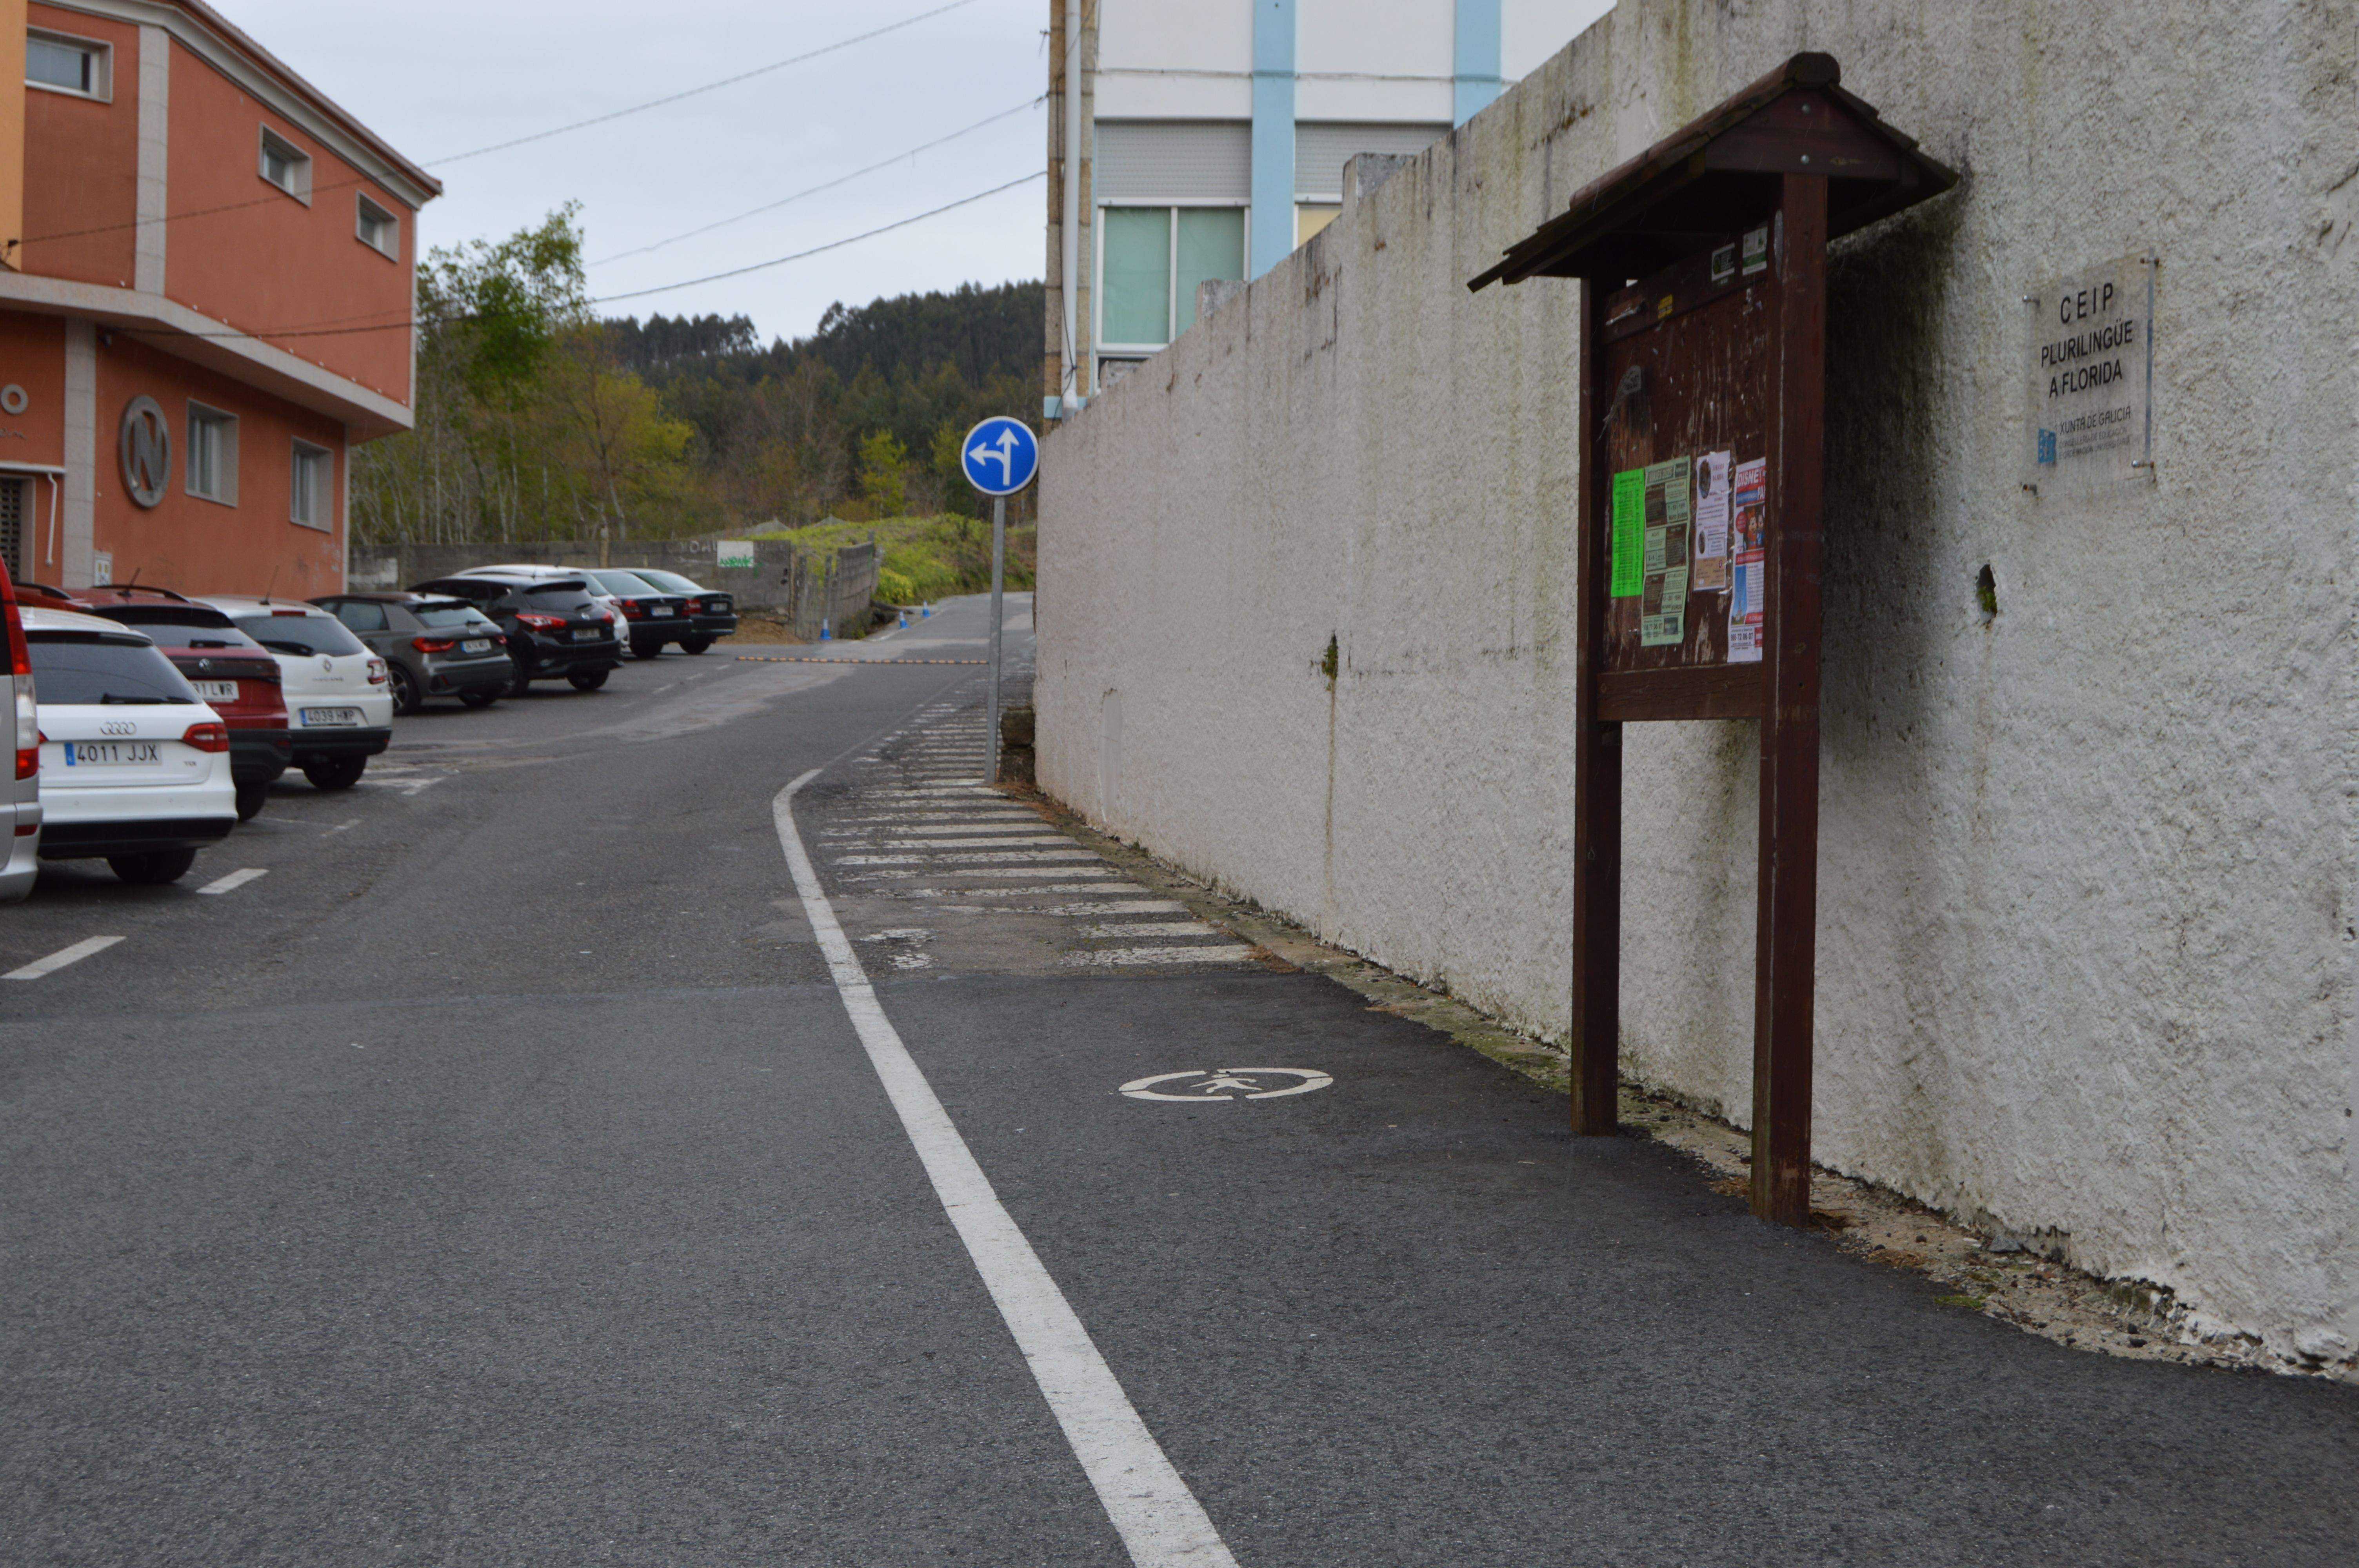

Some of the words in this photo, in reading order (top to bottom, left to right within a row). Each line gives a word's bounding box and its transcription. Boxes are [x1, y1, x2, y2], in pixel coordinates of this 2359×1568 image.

[2060, 283, 2113, 324] CEIP
[2041, 318, 2133, 368] PLURILINGÜE
[2049, 376, 2058, 398] A
[2062, 359, 2122, 395] FLORIDA
[2059, 417, 2085, 436] XUNTA
[2087, 414, 2097, 428] DE
[2098, 405, 2131, 426] GALICIA
[308, 710, 333, 721] 4039
[78, 745, 118, 762] 4011
[127, 744, 158, 762] JJX
